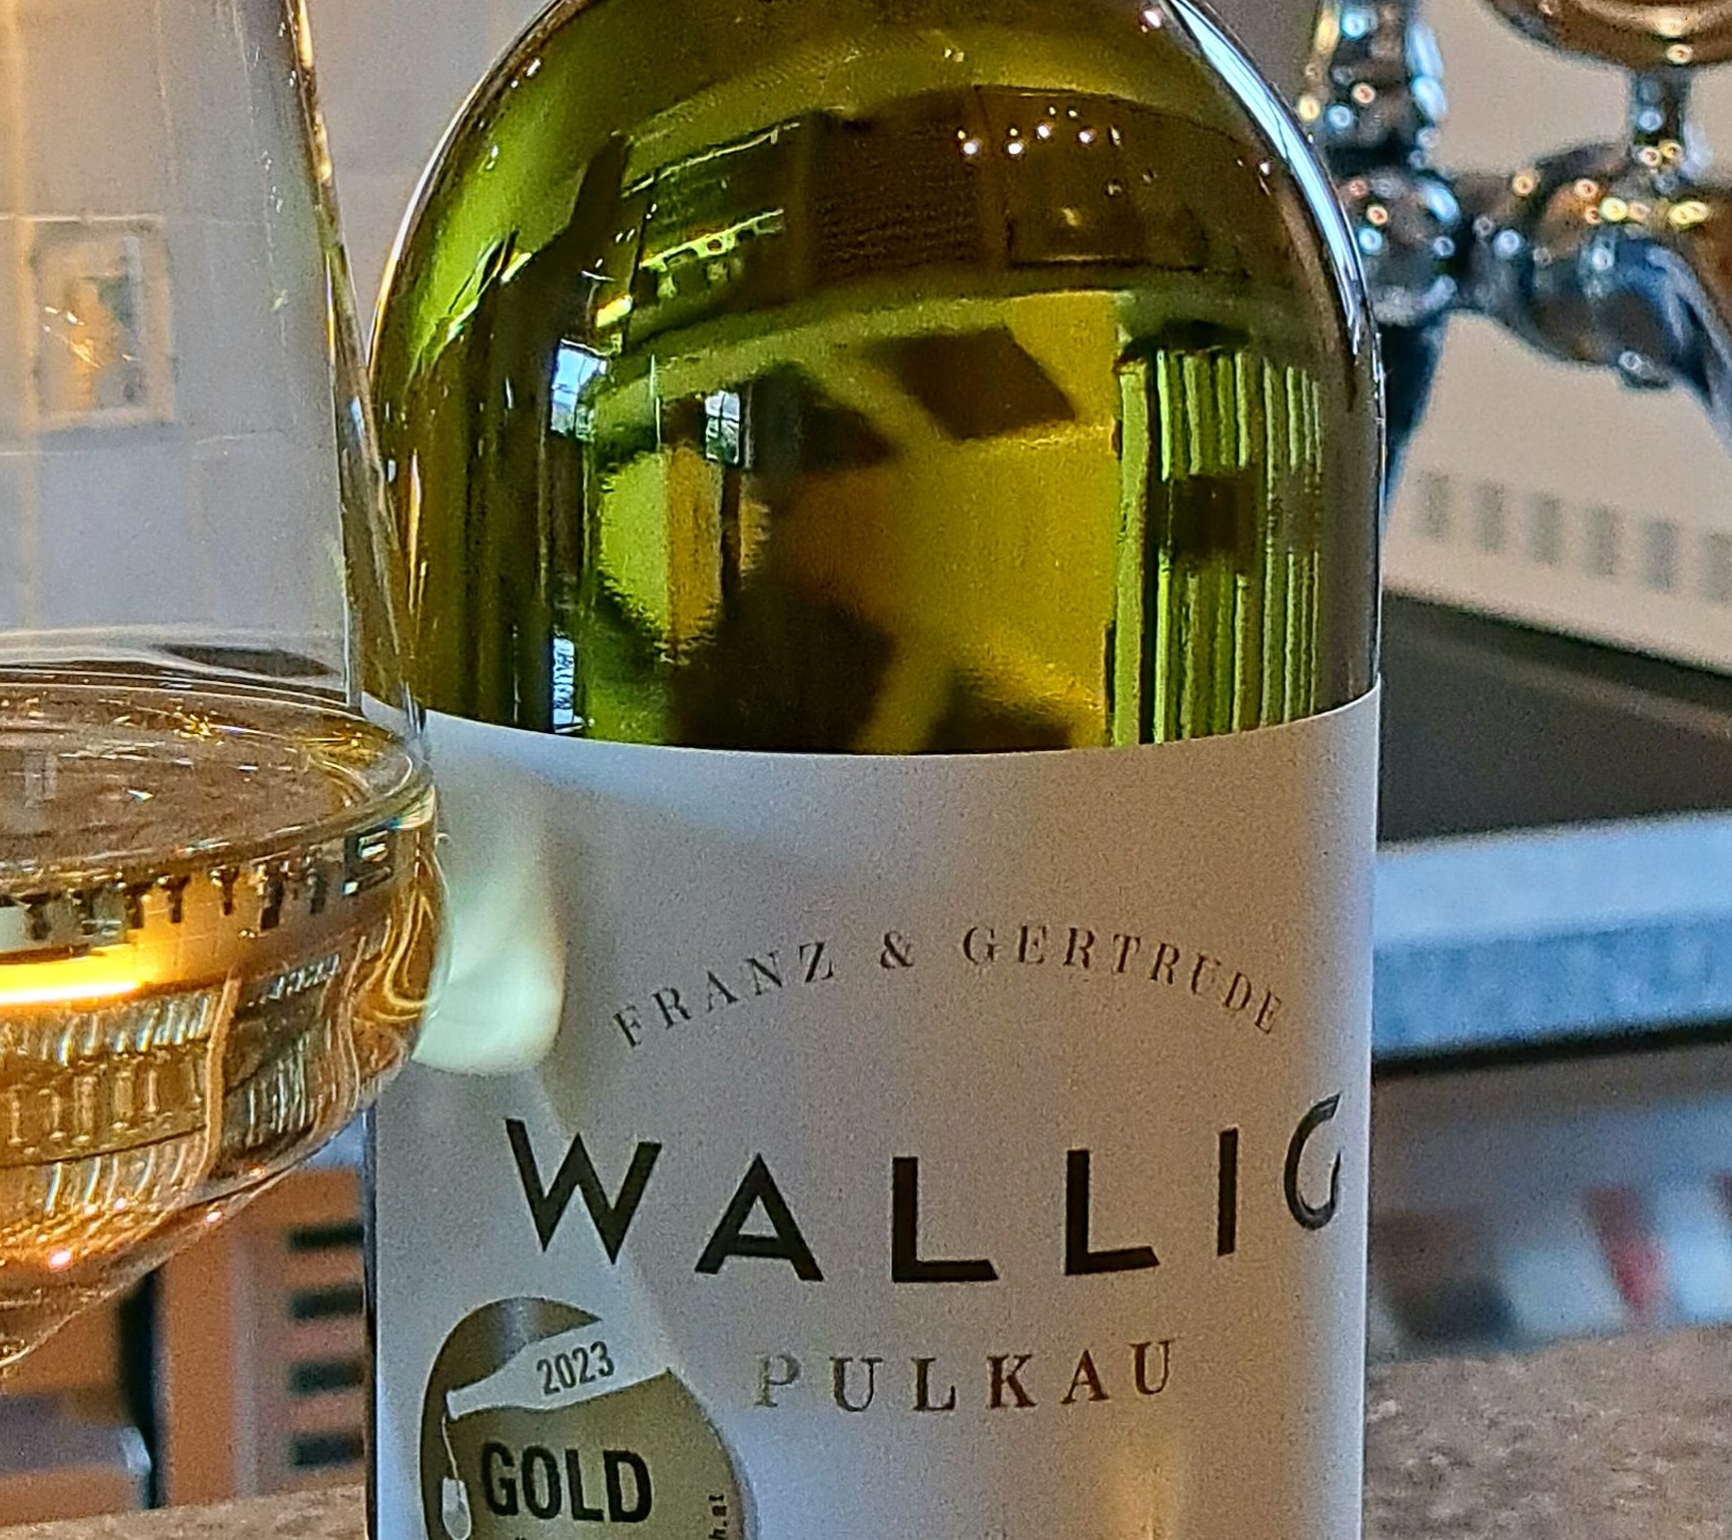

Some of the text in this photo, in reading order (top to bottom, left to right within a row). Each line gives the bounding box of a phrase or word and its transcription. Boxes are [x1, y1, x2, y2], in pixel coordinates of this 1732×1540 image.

[614, 923, 1283, 1049] FRANZ & GERTRUDE
[506, 1093, 1342, 1284] WALLIG
[537, 1340, 616, 1396] 2023
[753, 1340, 1176, 1412] PULKAU
[480, 1442, 653, 1523] GOLD
